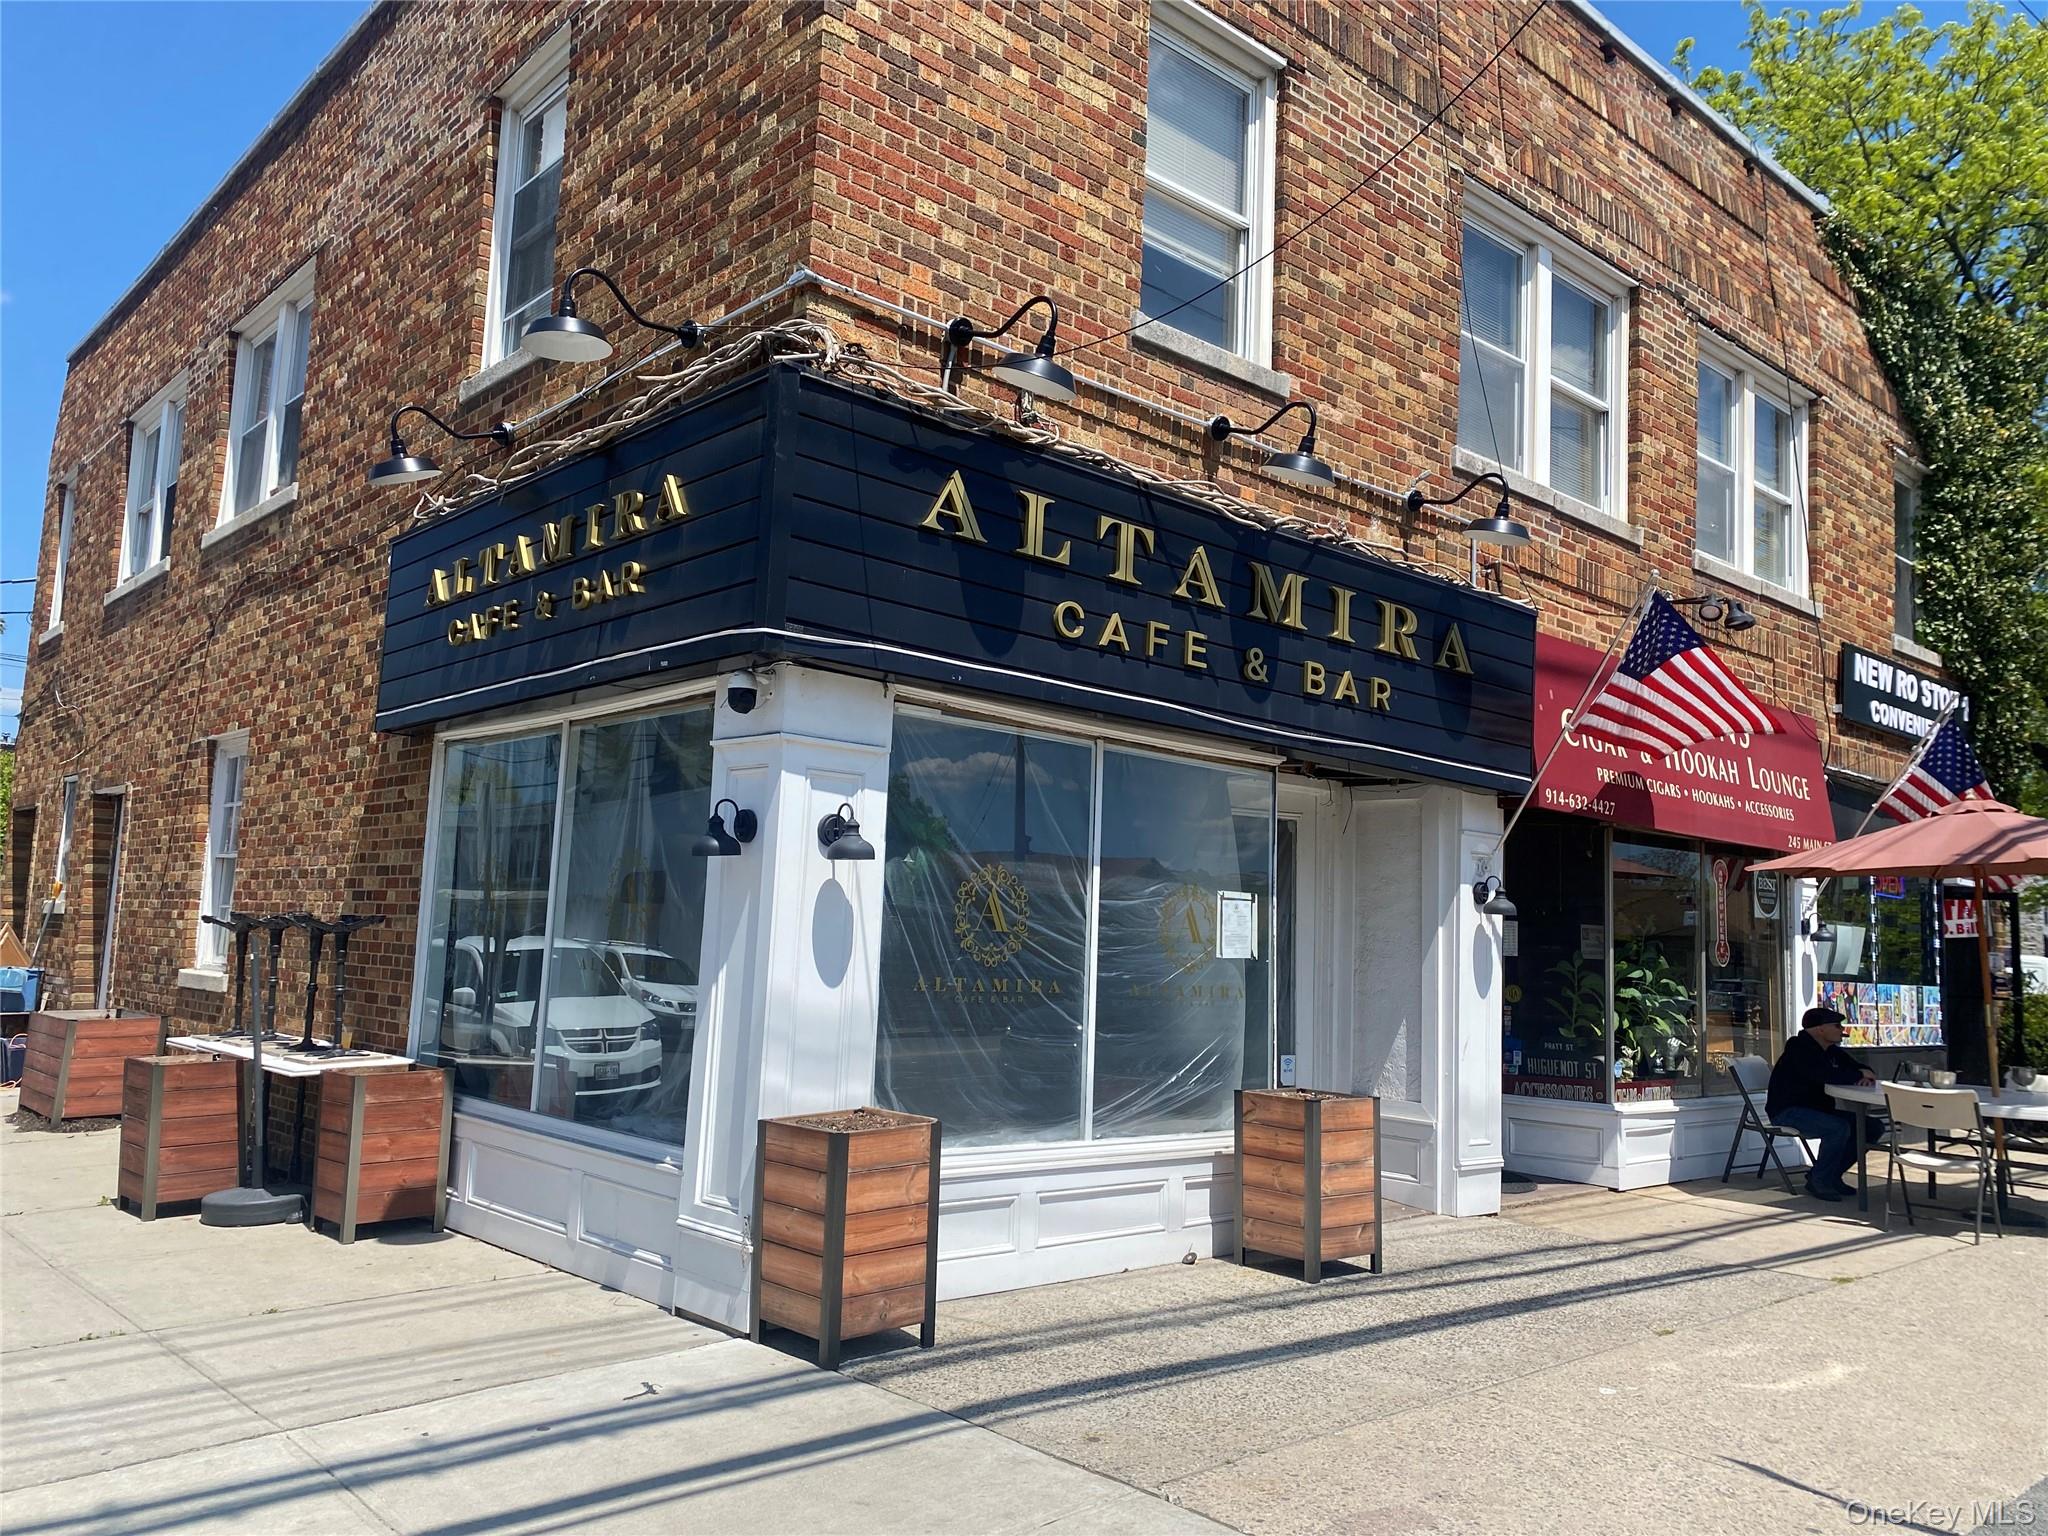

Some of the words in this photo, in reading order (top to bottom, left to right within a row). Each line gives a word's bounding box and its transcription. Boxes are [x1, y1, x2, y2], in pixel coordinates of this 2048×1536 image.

[424, 473, 691, 607] ALTAMIRA
[920, 469, 1474, 675] ALTAMIRA
[448, 598, 521, 647] CAFE
[534, 590, 557, 620] &
[571, 560, 646, 610] BAR
[1053, 600, 1208, 670] CAFE
[1244, 647, 1269, 684] &
[1304, 660, 1393, 712] BAR
[1854, 652, 1894, 693] NEW
[1895, 669, 1918, 702] RO
[1596, 767, 1645, 791] PREMIUM
[1646, 778, 1681, 799] CIGARS
[1691, 788, 1736, 810] HOOKAHS
[1745, 800, 1795, 821] ACCESSORIES
[1665, 747, 1740, 785] HOOKAH
[1747, 756, 1811, 801] LOUNGE
[1545, 788, 1616, 816] 914-632-4427
[1788, 835, 1801, 849] 245
[1803, 837, 1823, 850] MAIN
[1944, 899, 1978, 921] TM
[913, 975, 1062, 994] ALTAMIRA
[1527, 1057, 1579, 1078] HUGUENOT
